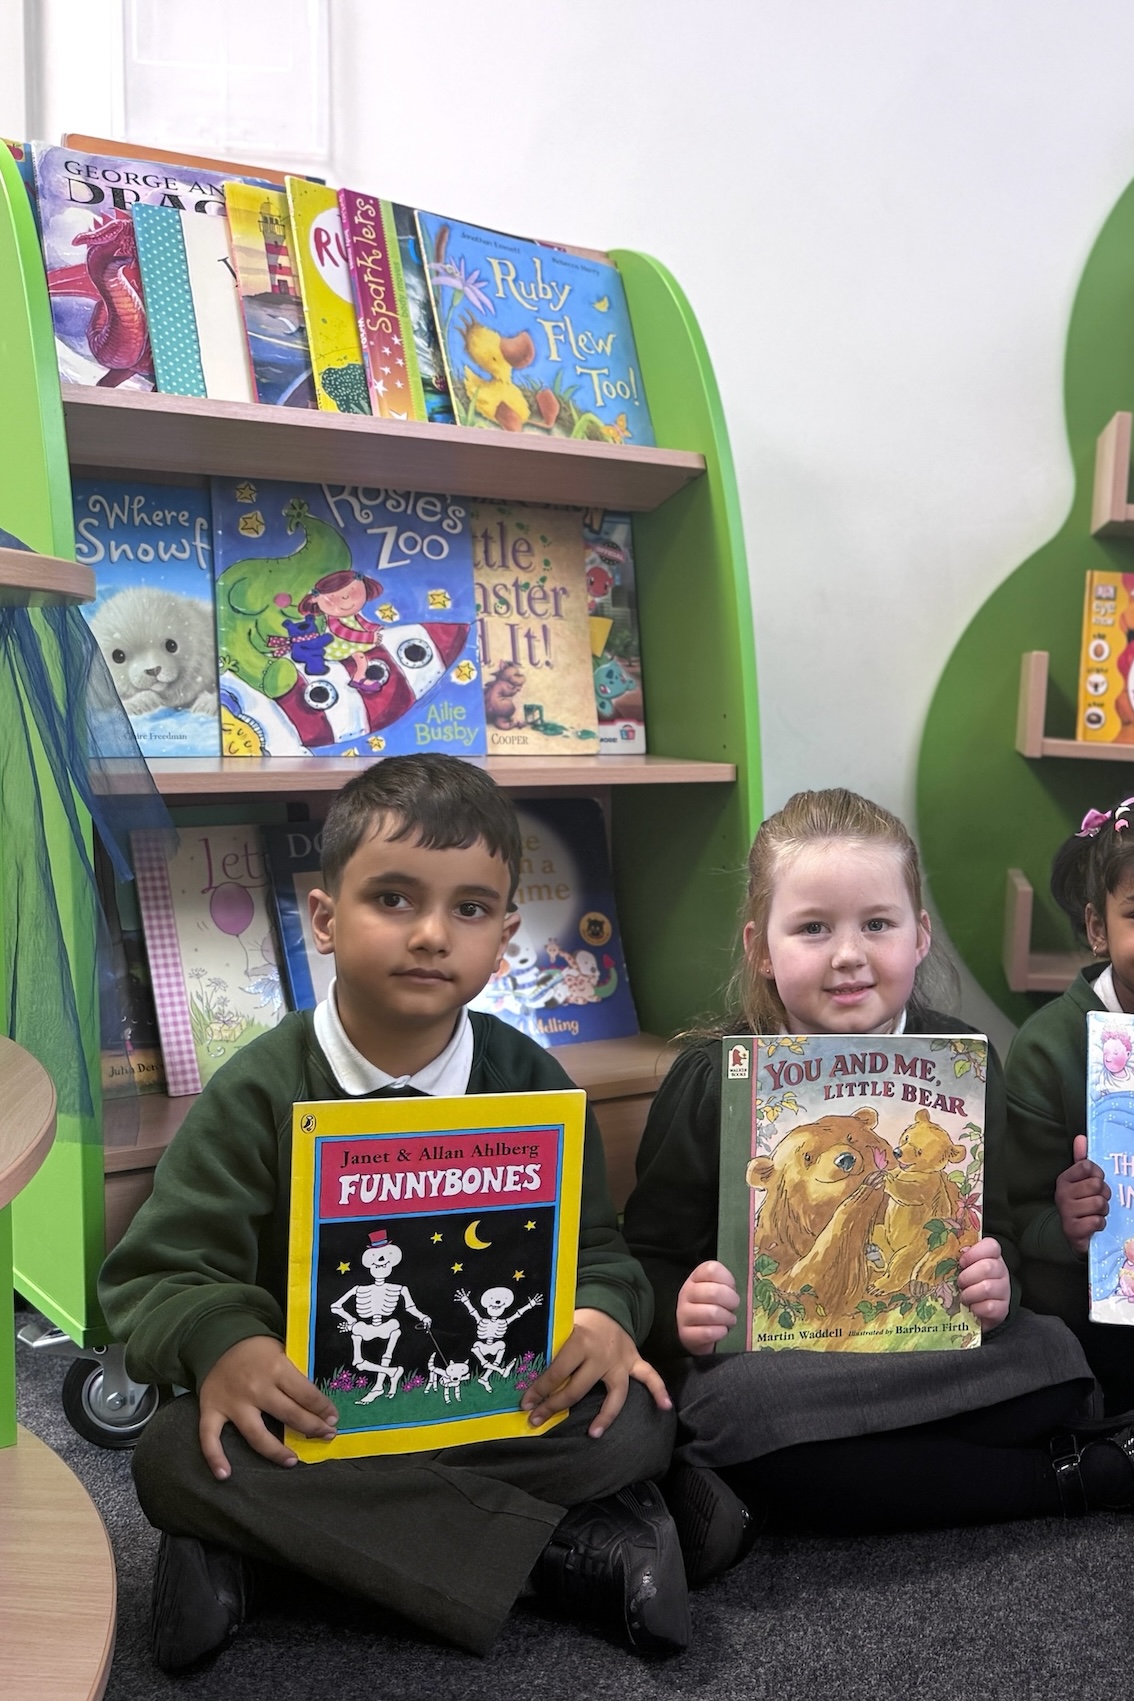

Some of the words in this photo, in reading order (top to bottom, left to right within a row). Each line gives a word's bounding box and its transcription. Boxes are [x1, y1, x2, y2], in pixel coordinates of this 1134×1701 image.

[64, 160, 179, 191] GEORGE
[353, 198, 400, 333] Sparklers
[487, 257, 571, 312] Ruby
[537, 316, 616, 361] Flew
[576, 366, 640, 407] Too!
[89, 495, 190, 530] Where
[367, 526, 450, 570] Zoo
[505, 623, 554, 669] It!
[426, 702, 466, 724] Ailie
[149, 731, 188, 741] Freedman
[415, 724, 479, 746] Busby
[491, 733, 529, 745] COOPER
[764, 1058, 823, 1091] YOU
[828, 1052, 889, 1077] AND
[893, 1053, 942, 1088] ME,
[823, 1081, 895, 1100] LITTLE
[902, 1085, 968, 1118] BEAR
[340, 1151, 390, 1168] Janet
[397, 1149, 411, 1162] &
[419, 1145, 464, 1161] Allan
[471, 1142, 539, 1158] Ahlberg
[338, 1164, 542, 1205] FUNNYBONES
[757, 1331, 794, 1342] Martin
[799, 1329, 842, 1340] Waddell
[885, 1328, 893, 1336] by
[895, 1324, 938, 1334] Barbara
[942, 1322, 969, 1332] Firth
